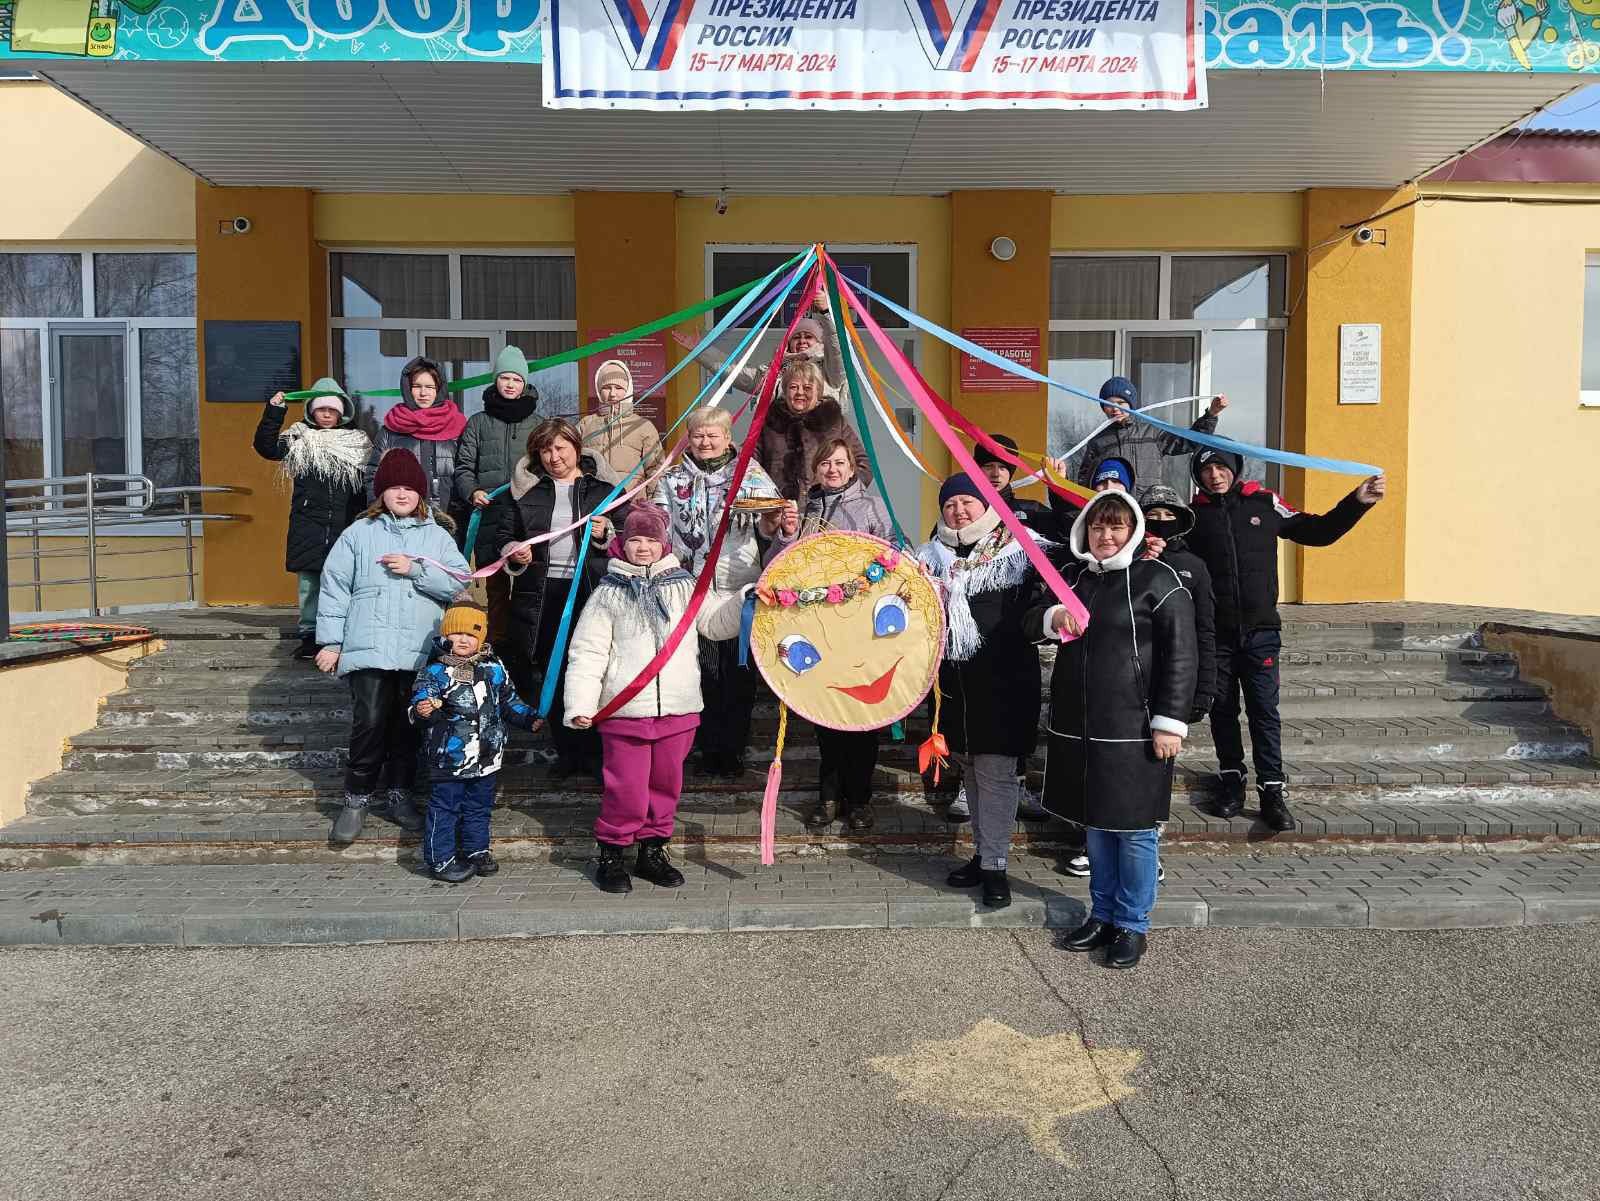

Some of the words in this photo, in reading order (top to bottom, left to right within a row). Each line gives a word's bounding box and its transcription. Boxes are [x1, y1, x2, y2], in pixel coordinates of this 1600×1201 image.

[707, 0, 857, 22] ПРЕЗИДЕНТА
[1012, 0, 1159, 24] ПРЕЗИДЕНТА
[697, 24, 794, 47] РОССИИ
[1000, 28, 1097, 50] РОССИИ
[738, 53, 794, 72] МАРТА
[796, 53, 838, 73] 2024
[1039, 56, 1097, 74] МАРТА
[1098, 56, 1139, 74] 2024
[999, 349, 1032, 358] РАБОТЫ
